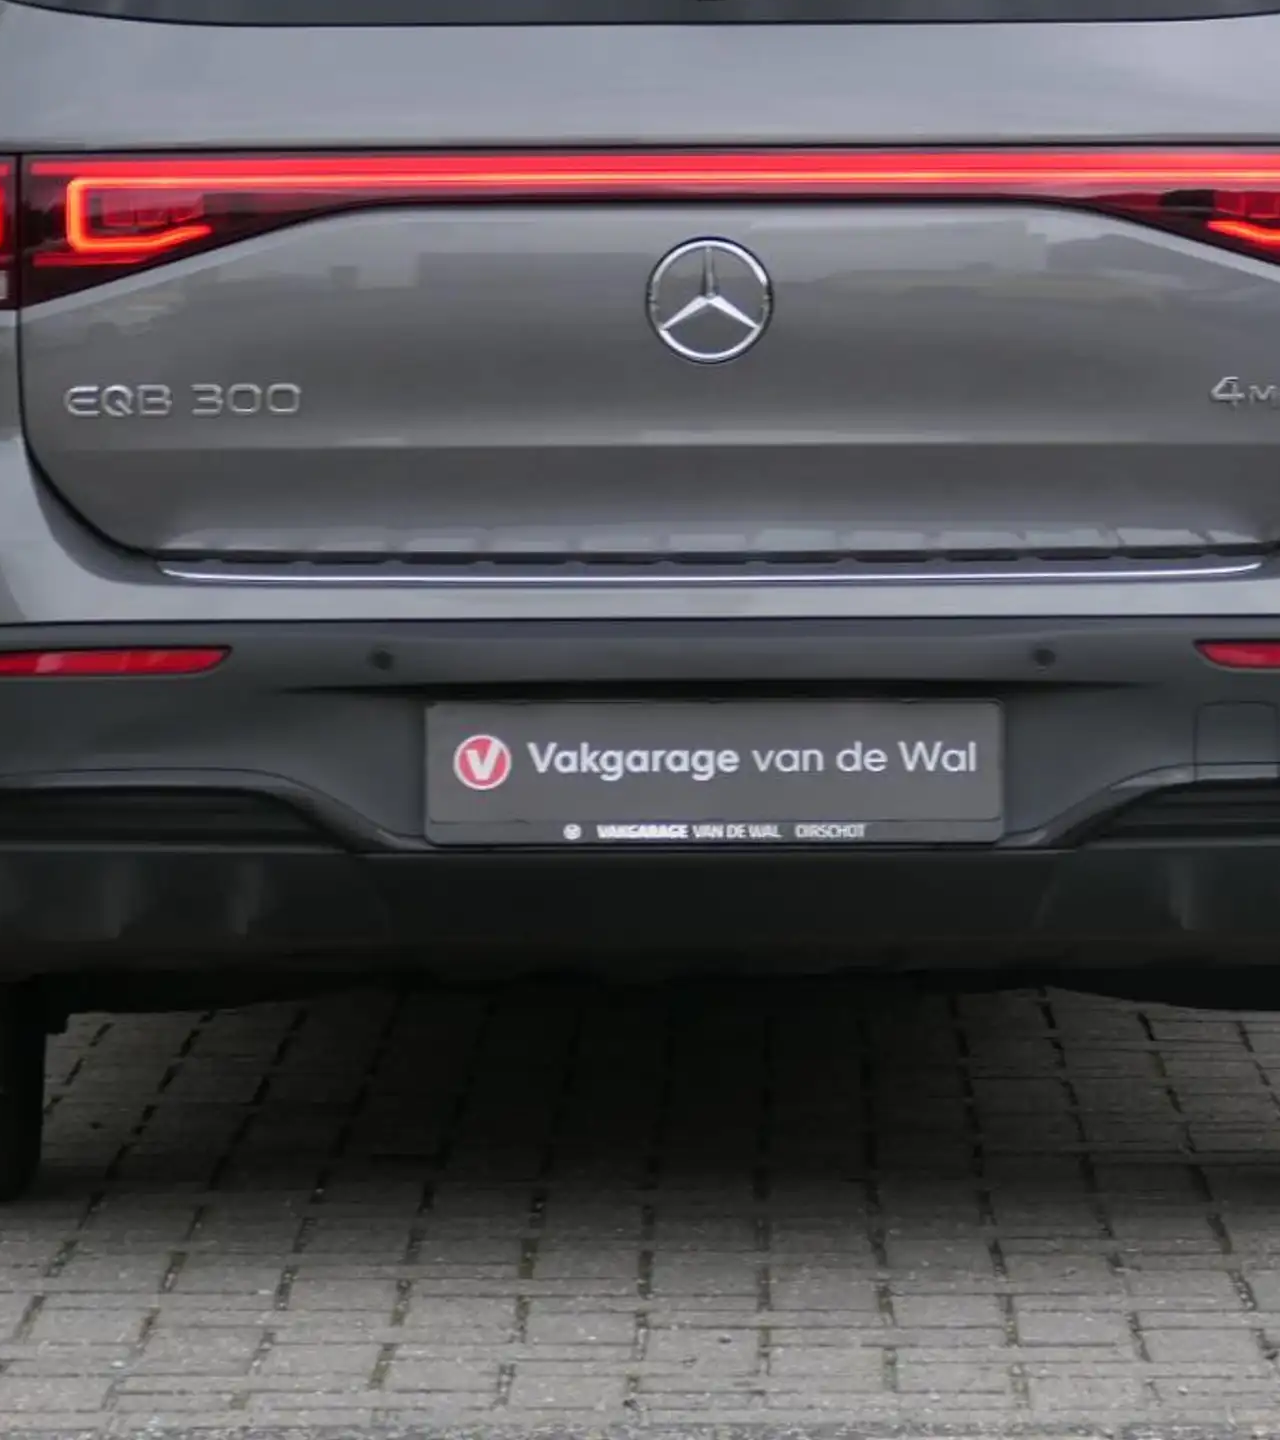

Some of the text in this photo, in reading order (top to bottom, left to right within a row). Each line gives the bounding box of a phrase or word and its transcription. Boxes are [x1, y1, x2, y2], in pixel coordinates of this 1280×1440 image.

[64, 382, 302, 417] EQB 300
[526, 740, 977, 782] Vakgarage van de Wal
[596, 823, 689, 839] VAKGARAGE
[692, 823, 724, 839] VAN
[726, 823, 747, 839] DE
[748, 823, 783, 839] WAL
